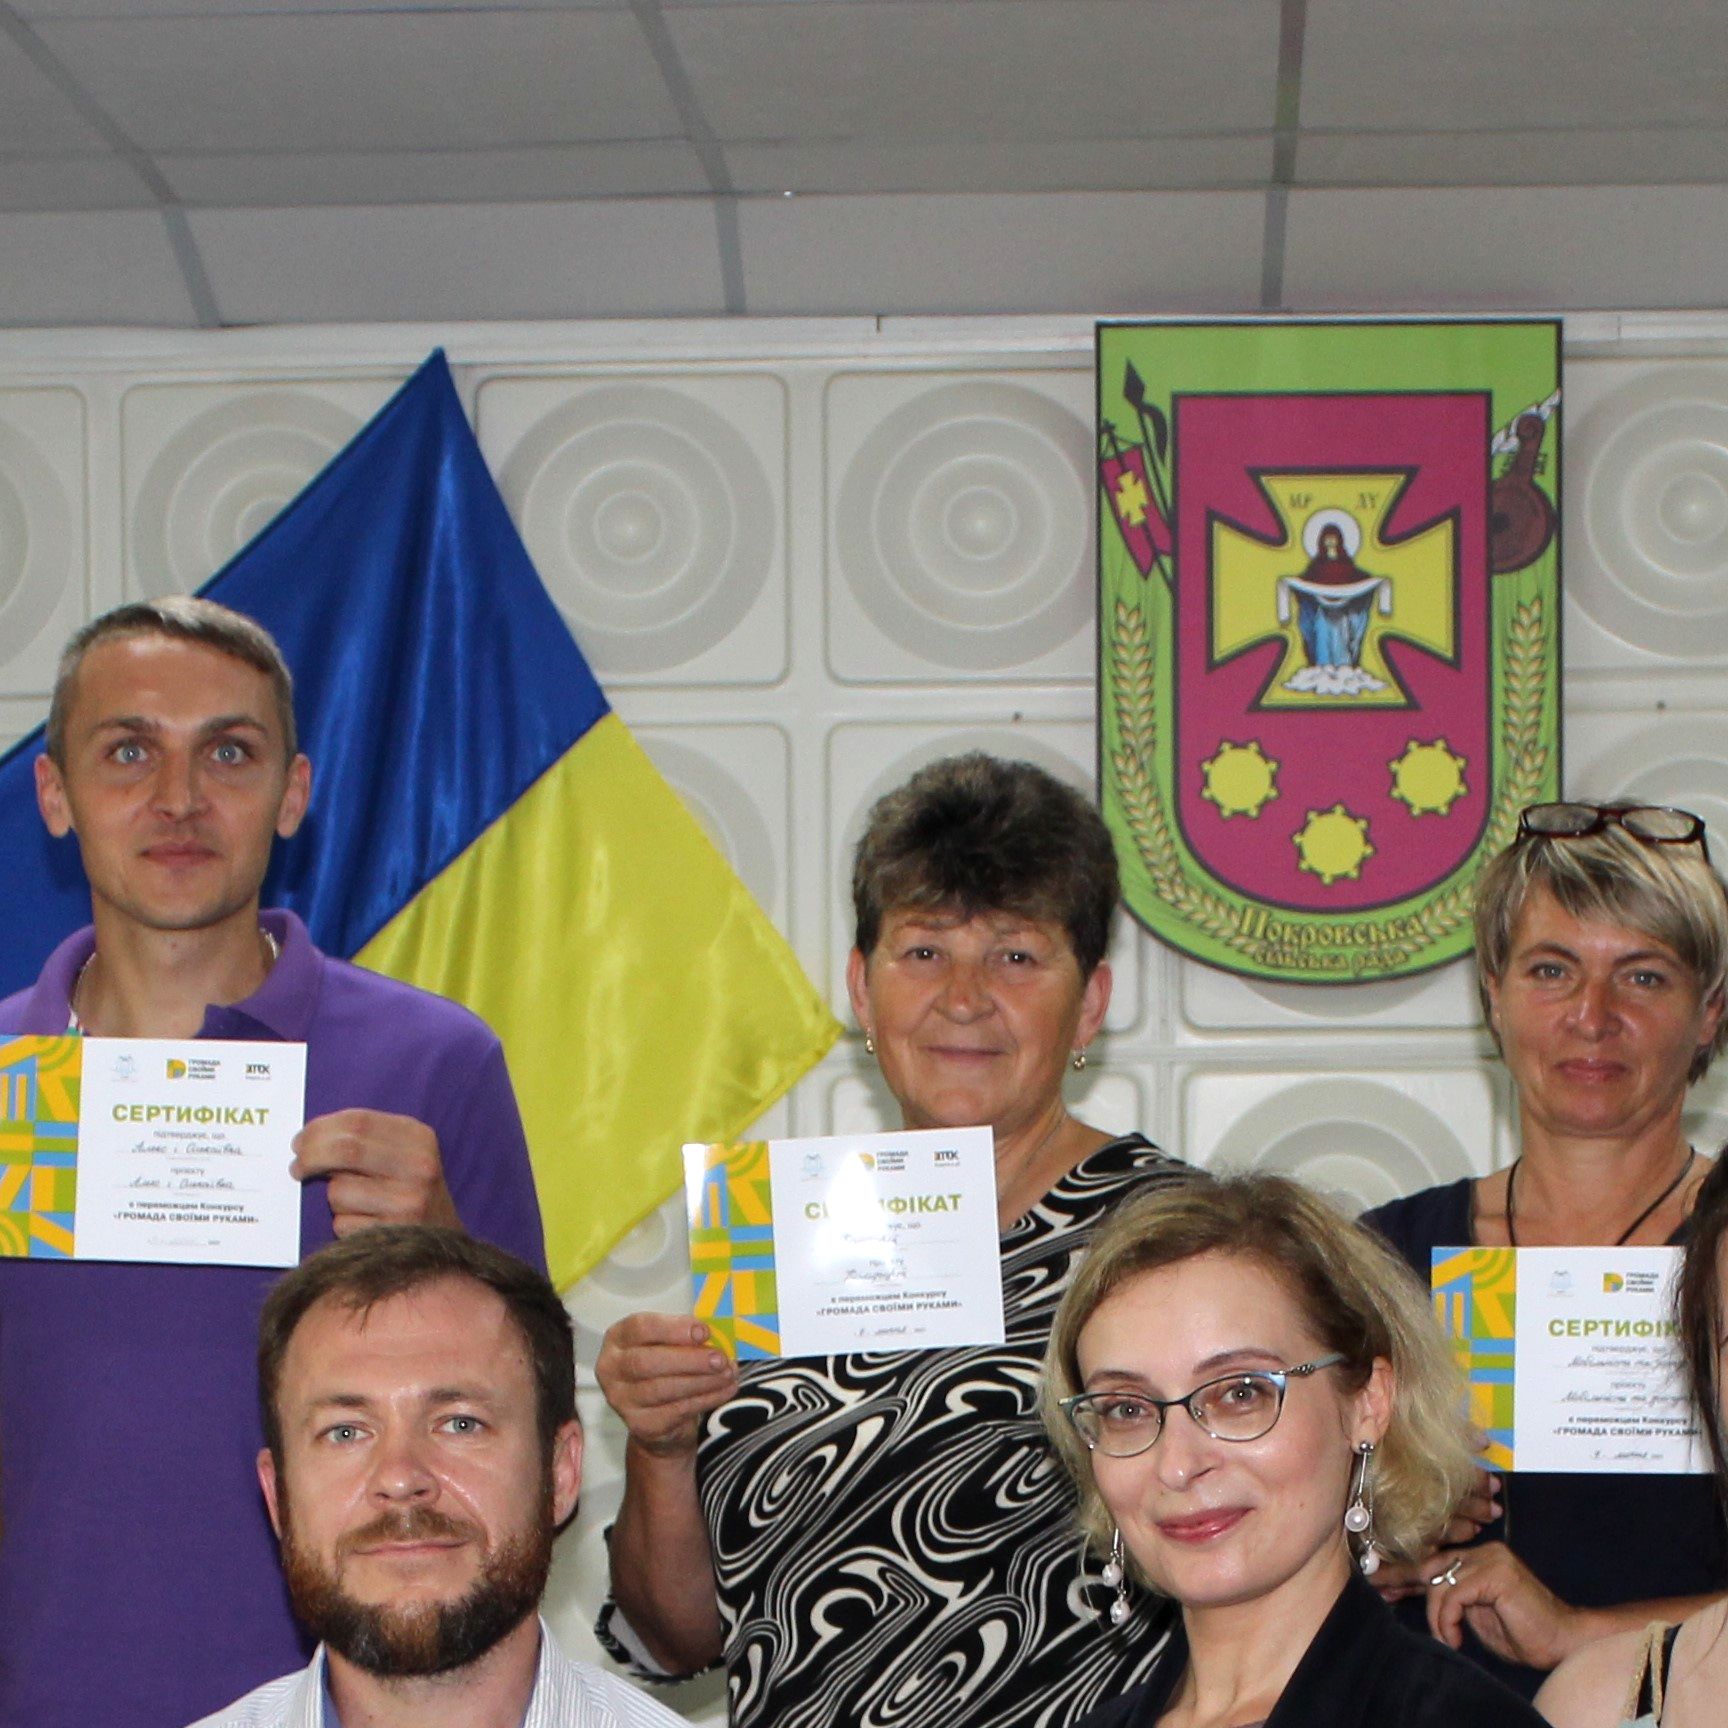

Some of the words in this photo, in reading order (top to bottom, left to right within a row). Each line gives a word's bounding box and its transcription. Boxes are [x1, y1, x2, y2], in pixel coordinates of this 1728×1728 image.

[113, 1104, 269, 1125] СЕРТИФІКАТ
[137, 1202, 198, 1210] переможцем
[201, 1203, 244, 1212] Конкурсу
[114, 1212, 166, 1221] «ГРОМАДА
[169, 1212, 210, 1222] СВОЇМИ
[213, 1214, 259, 1223] РУКАМИ»
[839, 1292, 901, 1303] переможцем
[903, 1290, 946, 1300] Конкурсу
[817, 1306, 869, 1316] «ГРОМАДА
[872, 1302, 913, 1313] СВОЇМИ
[917, 1301, 962, 1311] РУКАМИ»
[1553, 1427, 1607, 1436] «ГРОМАДА
[1611, 1426, 1651, 1436] СВОЇМИ
